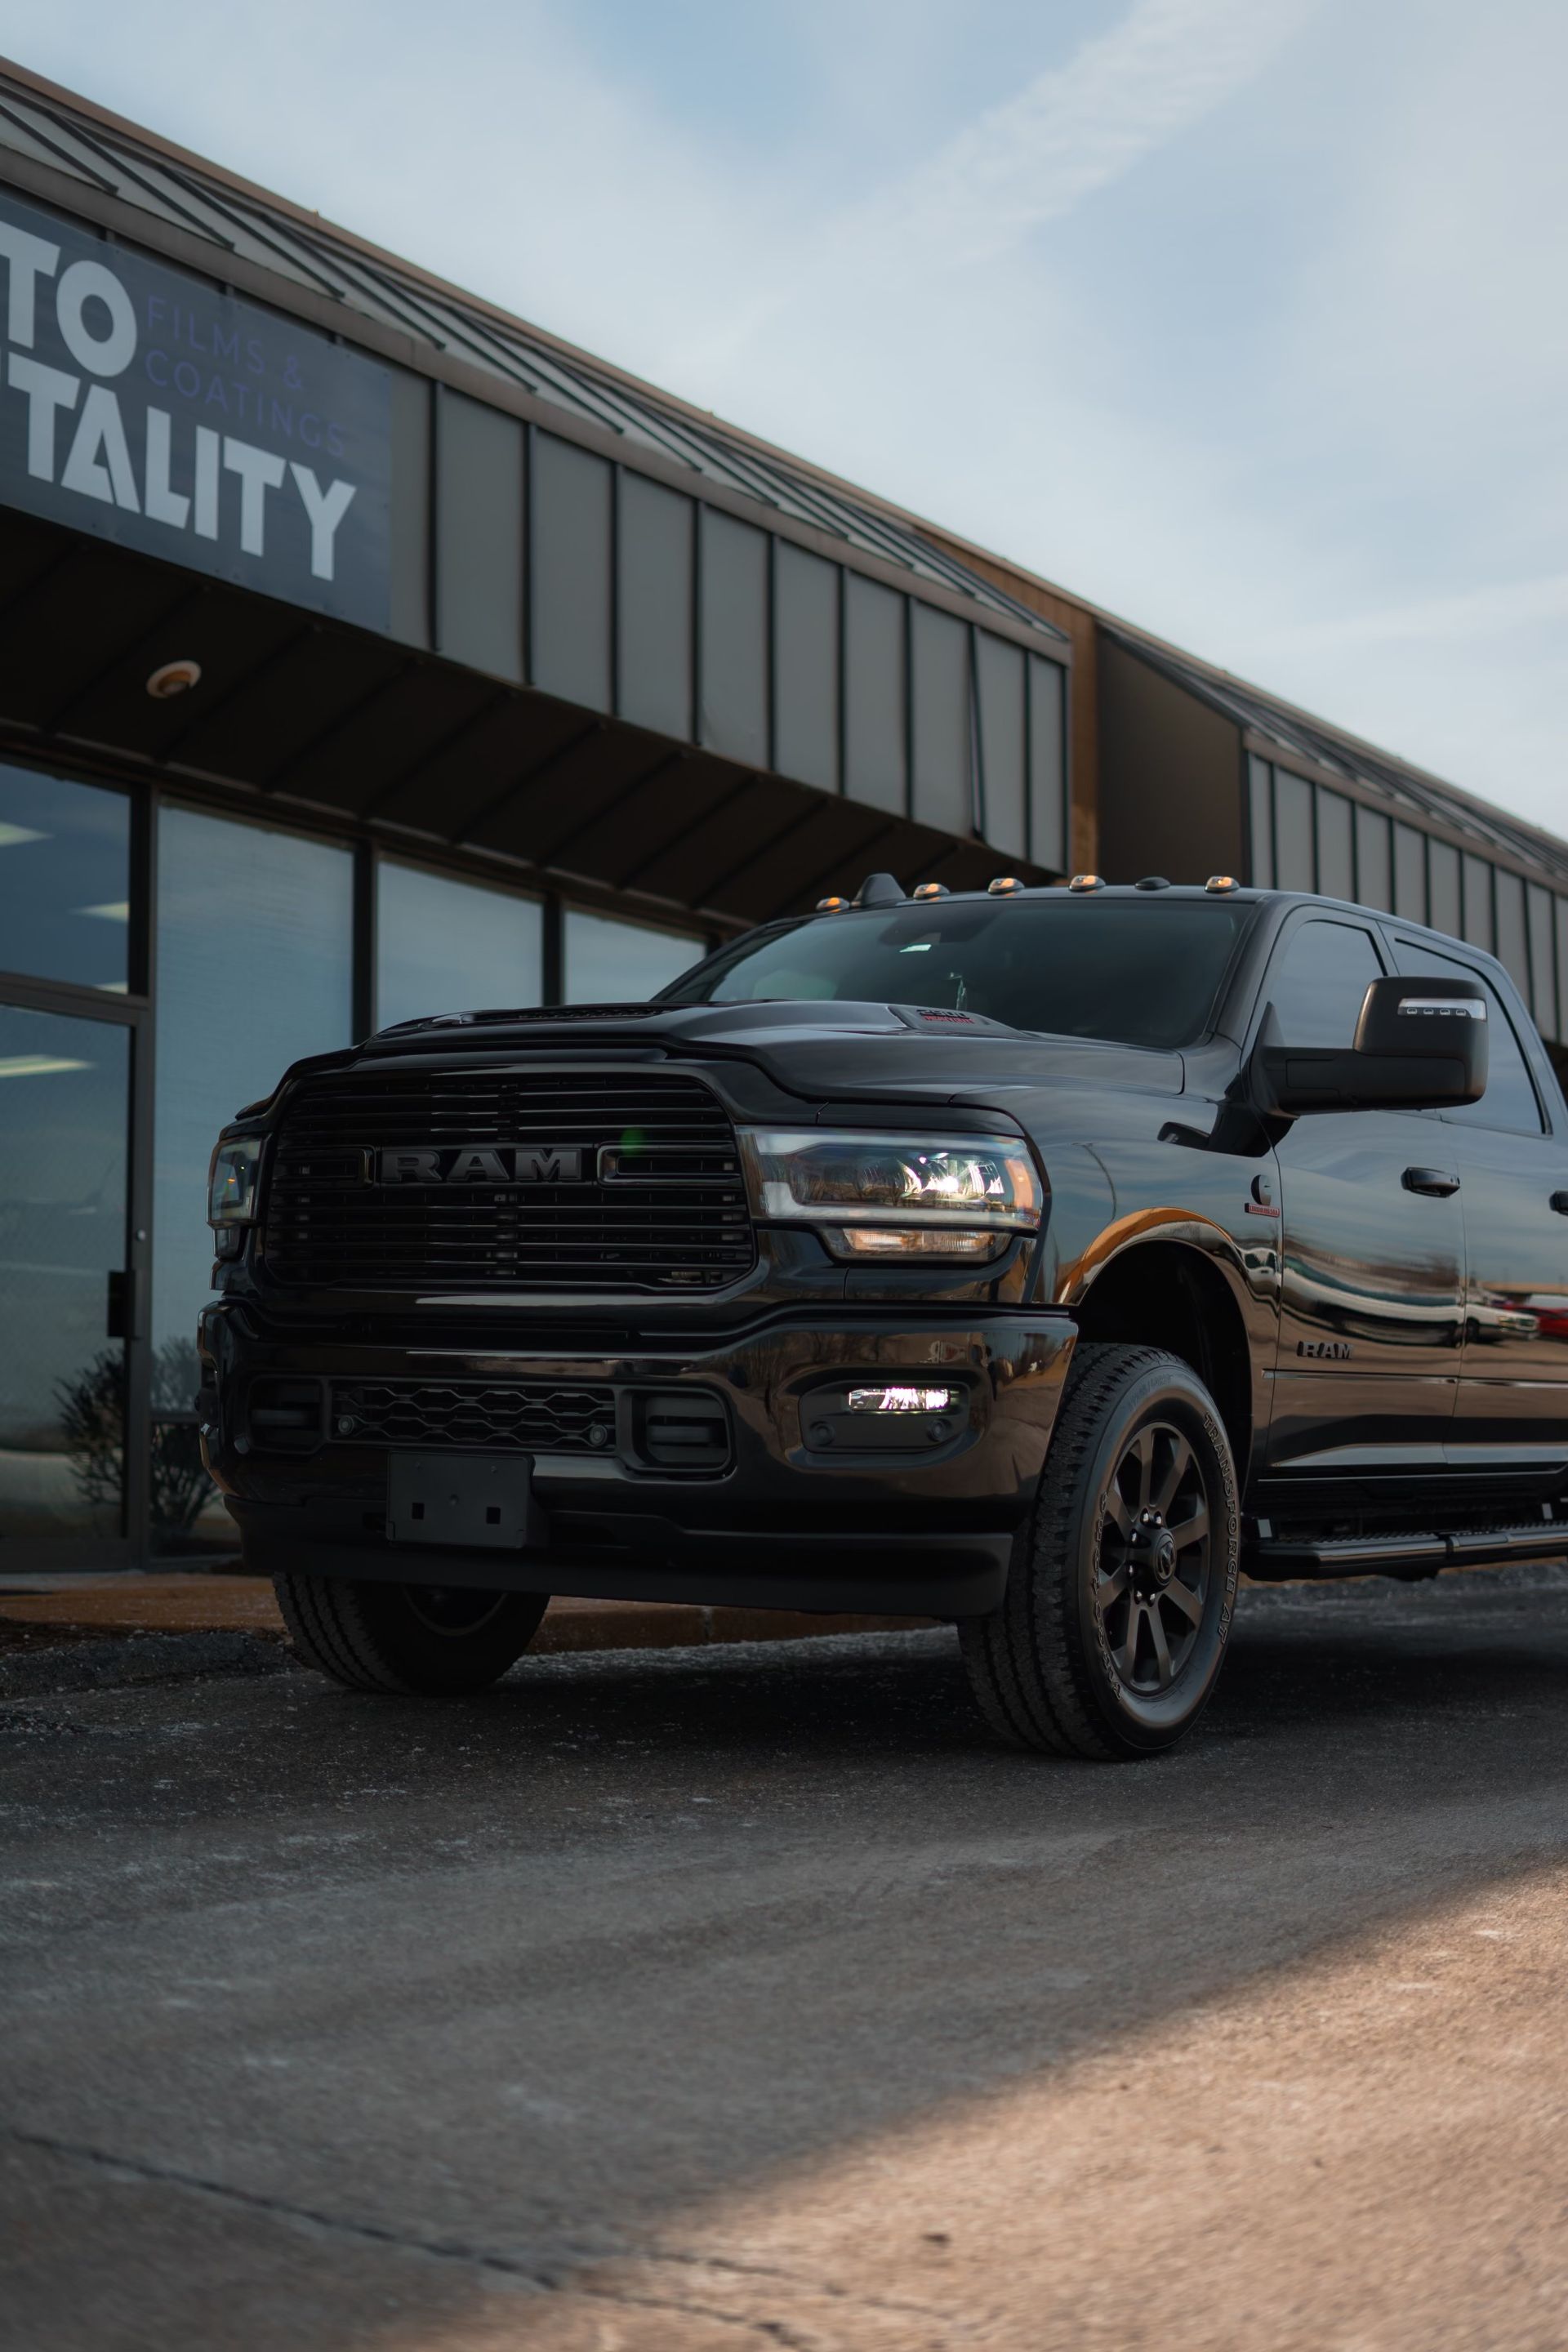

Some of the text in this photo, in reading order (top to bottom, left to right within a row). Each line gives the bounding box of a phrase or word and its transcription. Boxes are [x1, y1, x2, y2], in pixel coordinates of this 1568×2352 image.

[147, 295, 304, 391] FILMS &
[145, 350, 346, 458] COATINGS
[381, 1147, 581, 1182] RAM
[1297, 1340, 1354, 1360] RAM
[1202, 1411, 1238, 1594] TRANSFORCE
